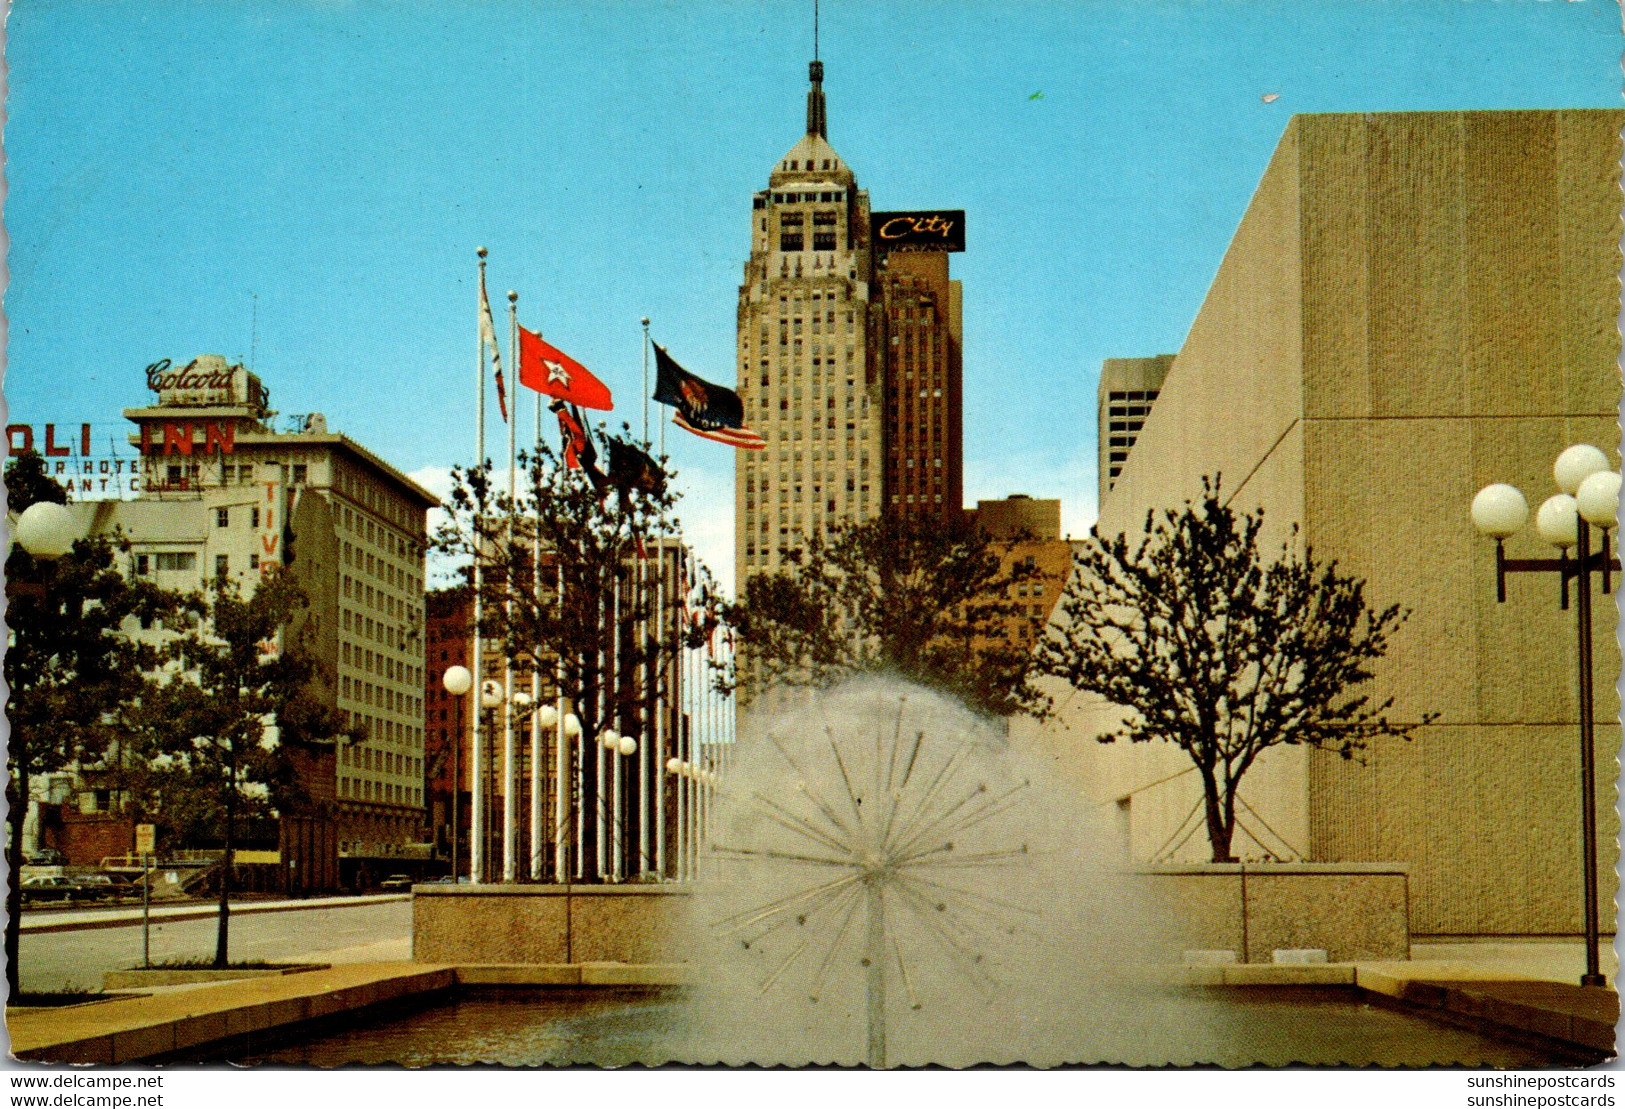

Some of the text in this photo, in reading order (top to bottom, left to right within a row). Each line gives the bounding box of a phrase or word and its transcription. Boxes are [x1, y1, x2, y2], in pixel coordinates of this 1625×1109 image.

[880, 215, 954, 239] City
[145, 358, 239, 393] Colcord
[141, 422, 234, 456] INN
[84, 460, 151, 474] HOTEL
